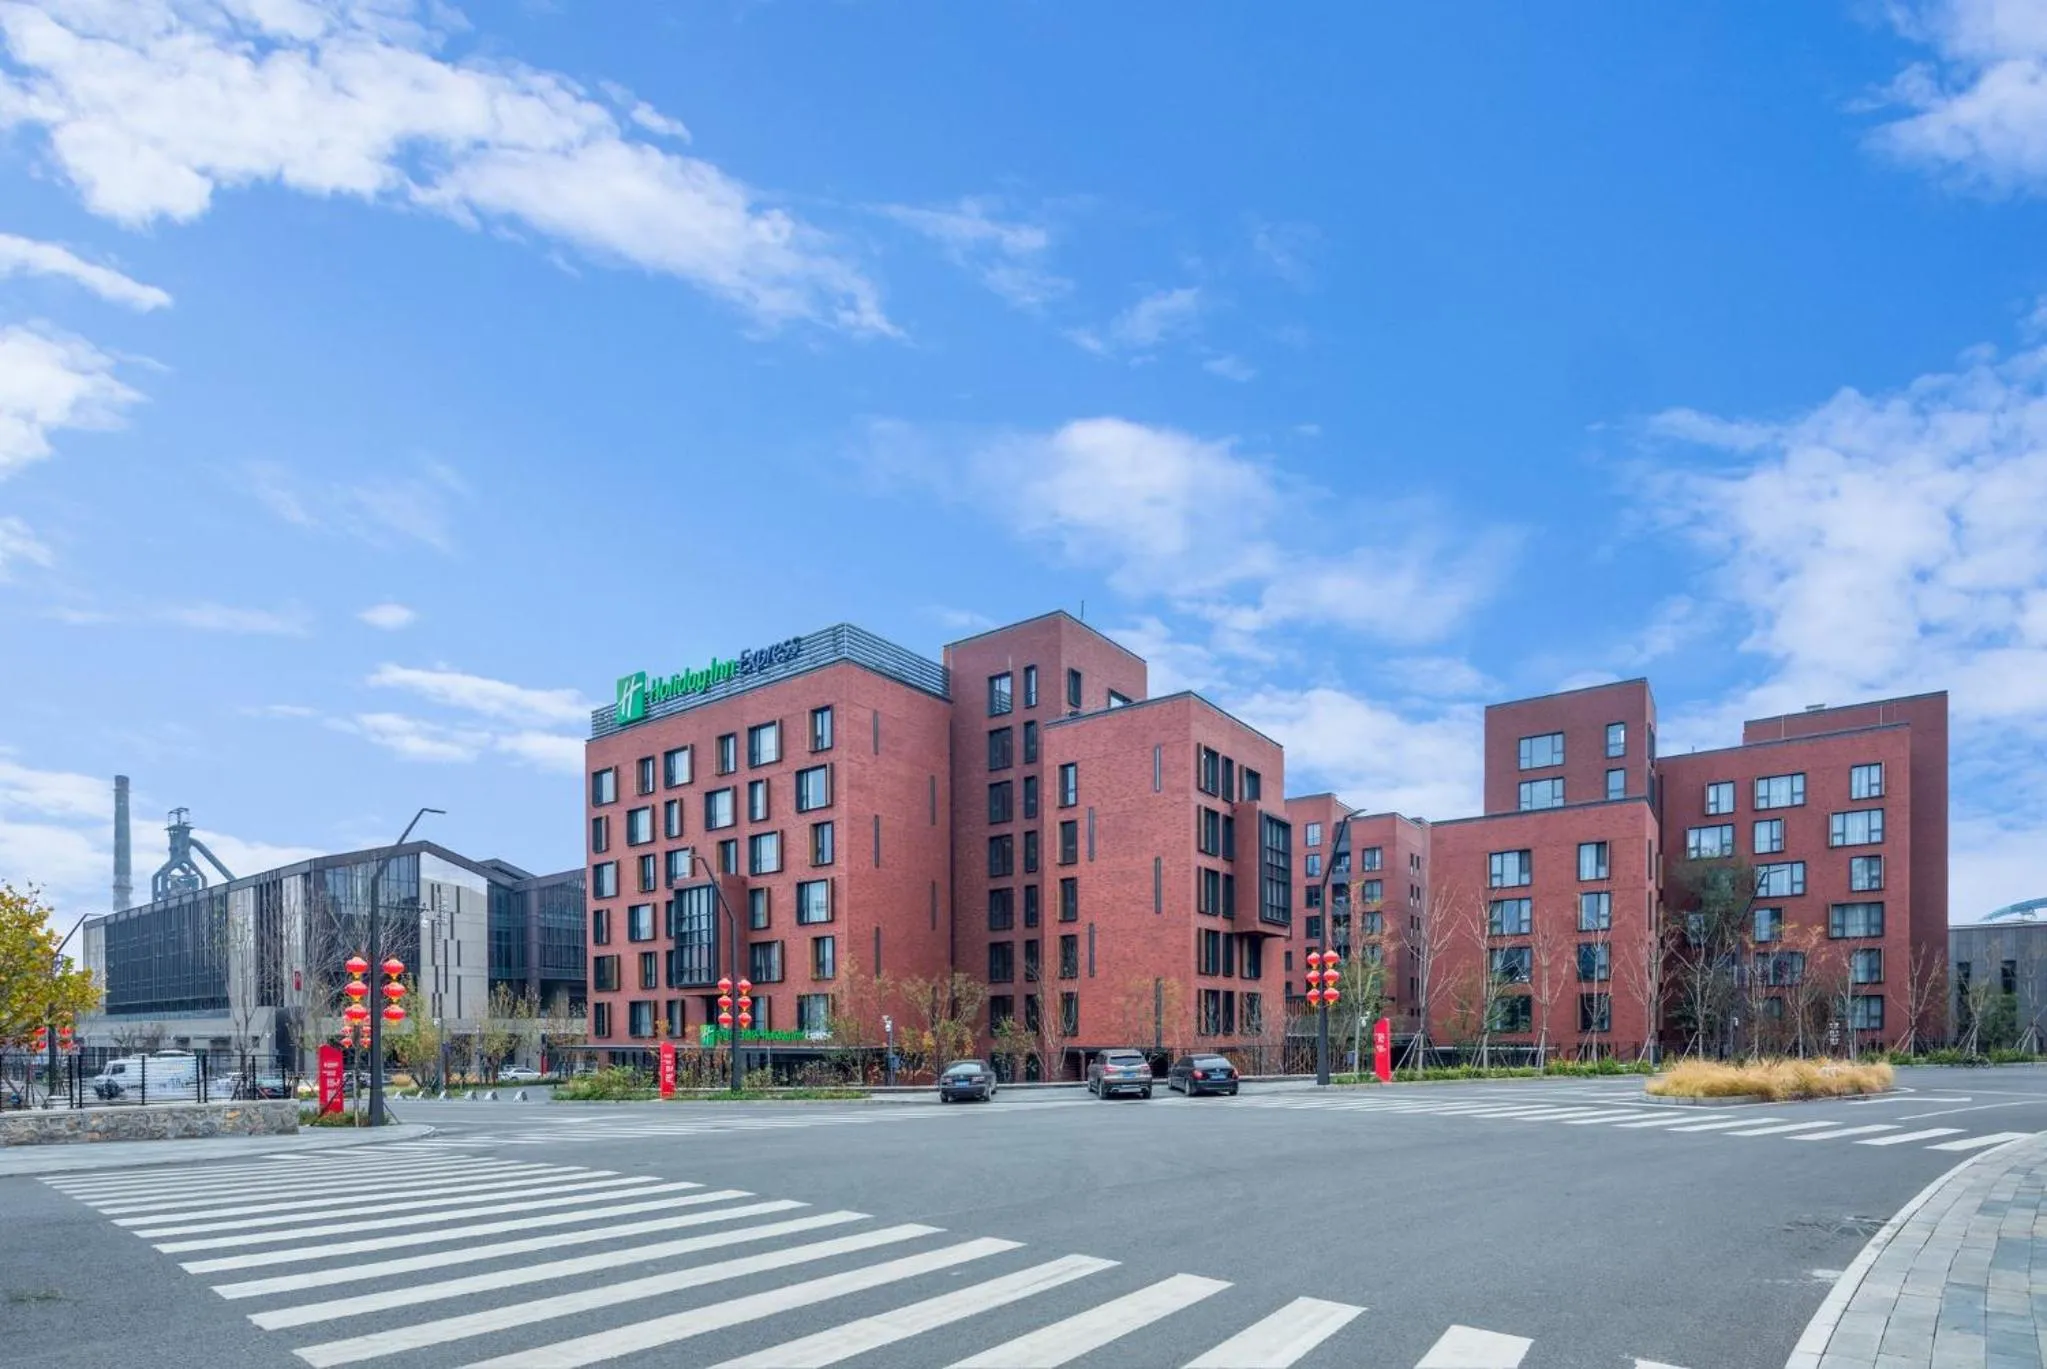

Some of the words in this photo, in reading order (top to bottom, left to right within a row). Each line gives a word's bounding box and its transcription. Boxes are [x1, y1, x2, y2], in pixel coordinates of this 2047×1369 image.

[651, 666, 710, 703] Holiday
[711, 657, 738, 684] Inn
[740, 636, 801, 674] Express
